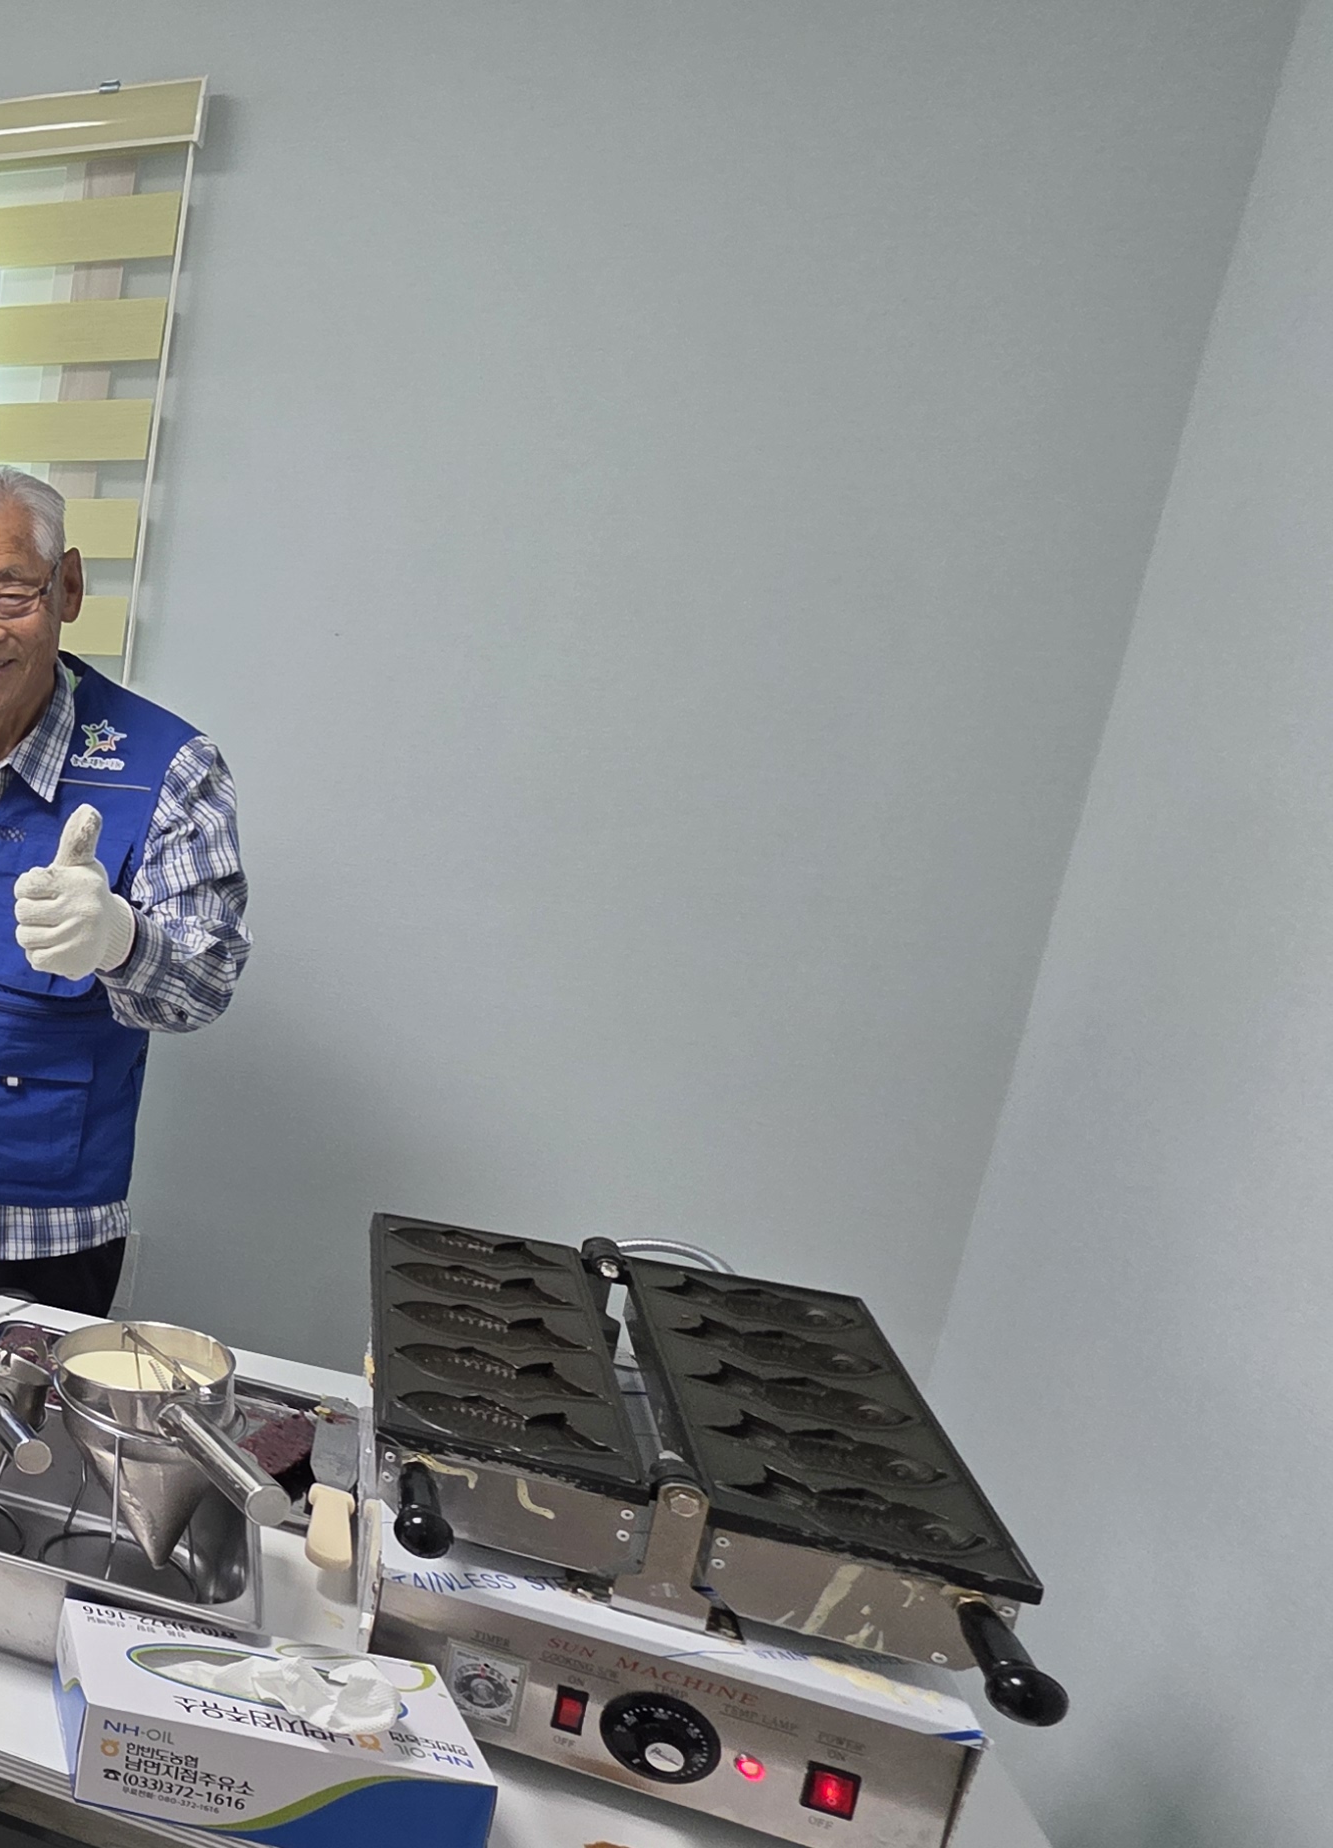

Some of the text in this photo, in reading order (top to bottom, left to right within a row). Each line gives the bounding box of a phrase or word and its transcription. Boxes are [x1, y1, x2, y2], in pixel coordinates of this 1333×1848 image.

[392, 1571, 516, 1593] TAINLESS
[82, 1605, 221, 1638] (033)372-1616
[474, 1629, 511, 1647] TIMER
[541, 1651, 619, 1680] COOKING S/W
[547, 1637, 761, 1707] SUN MACHINE
[568, 1676, 585, 1687] ON
[722, 1703, 799, 1732] TEMP LAMP
[389, 1731, 470, 1757] 한반도농협
[553, 1736, 577, 1748] OFF
[818, 1730, 866, 1751] POWER
[126, 1742, 199, 1769] 한반도농협
[828, 1750, 846, 1762] ON
[125, 1756, 255, 1797] 남면지점주유소
[122, 1786, 220, 1814] 무료전화: 080-372-1616
[123, 1771, 245, 1811] (033)372-1616
[808, 1815, 835, 1830] OFF
